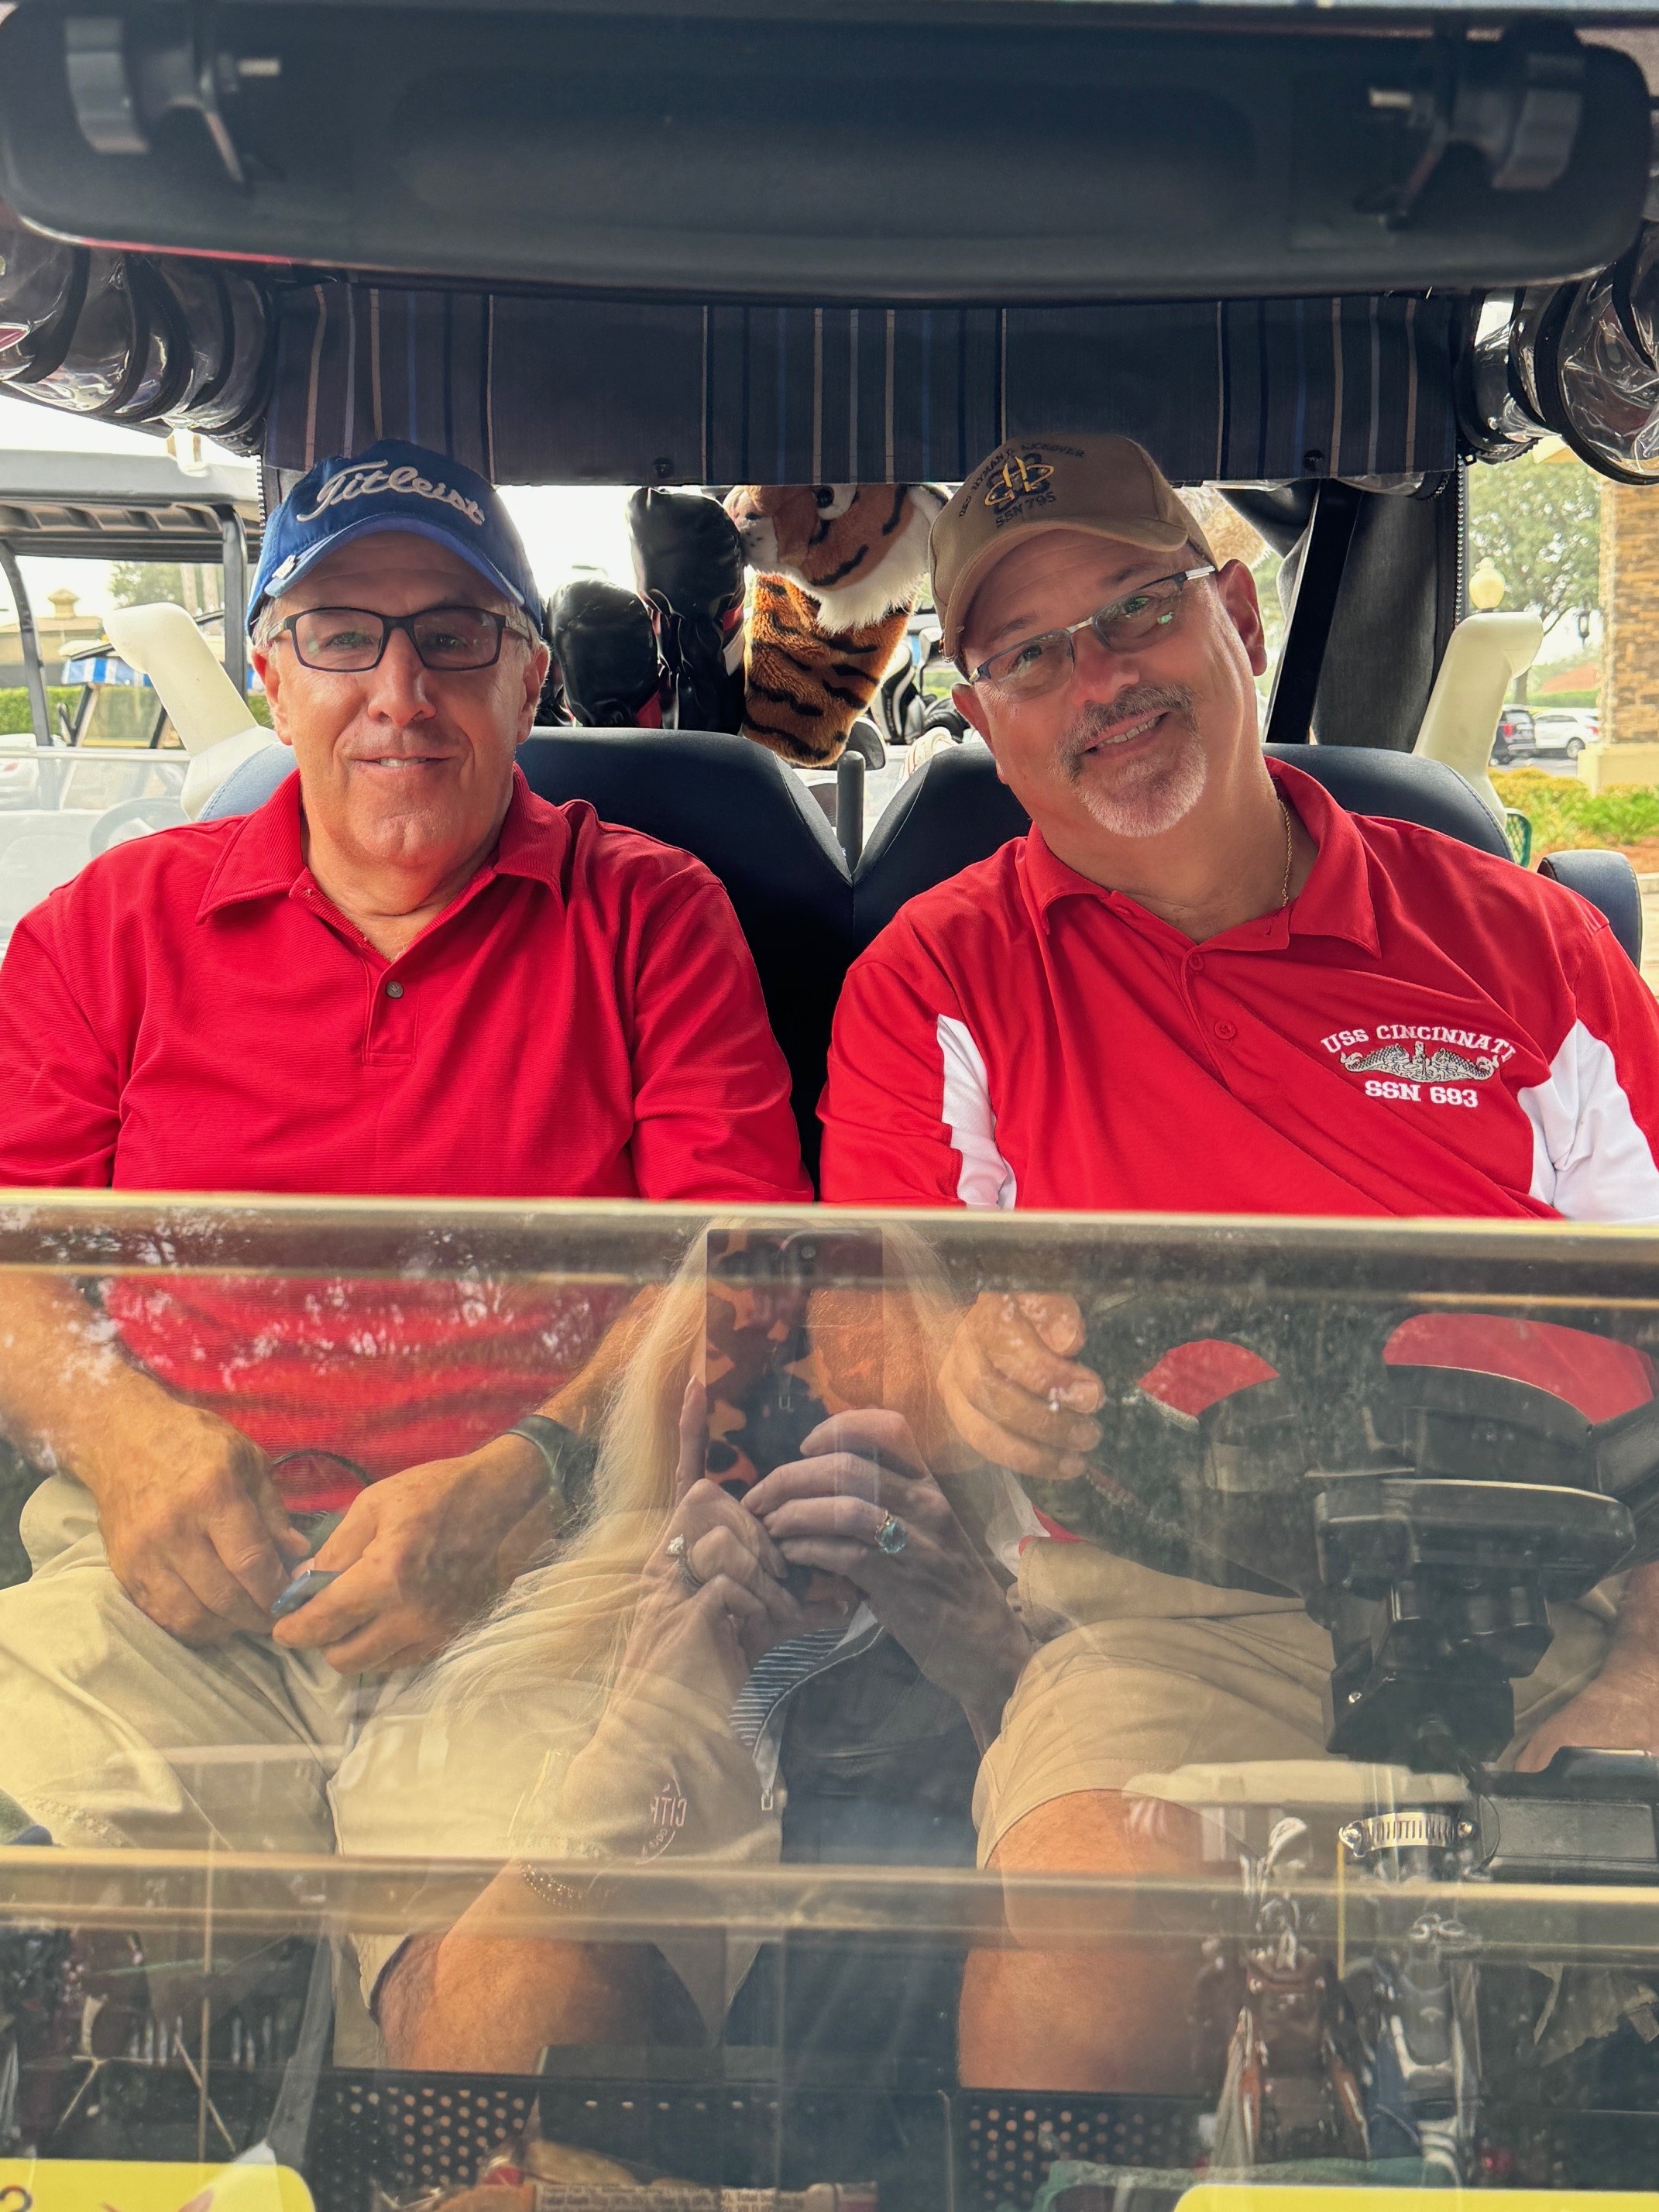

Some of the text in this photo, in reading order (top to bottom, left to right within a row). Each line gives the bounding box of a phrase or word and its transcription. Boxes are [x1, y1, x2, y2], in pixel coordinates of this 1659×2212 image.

[297, 460, 486, 526] Titleist
[1321, 1025, 1516, 1063] USS CINCINNATI
[1365, 1080, 1479, 1108] SSN 693
